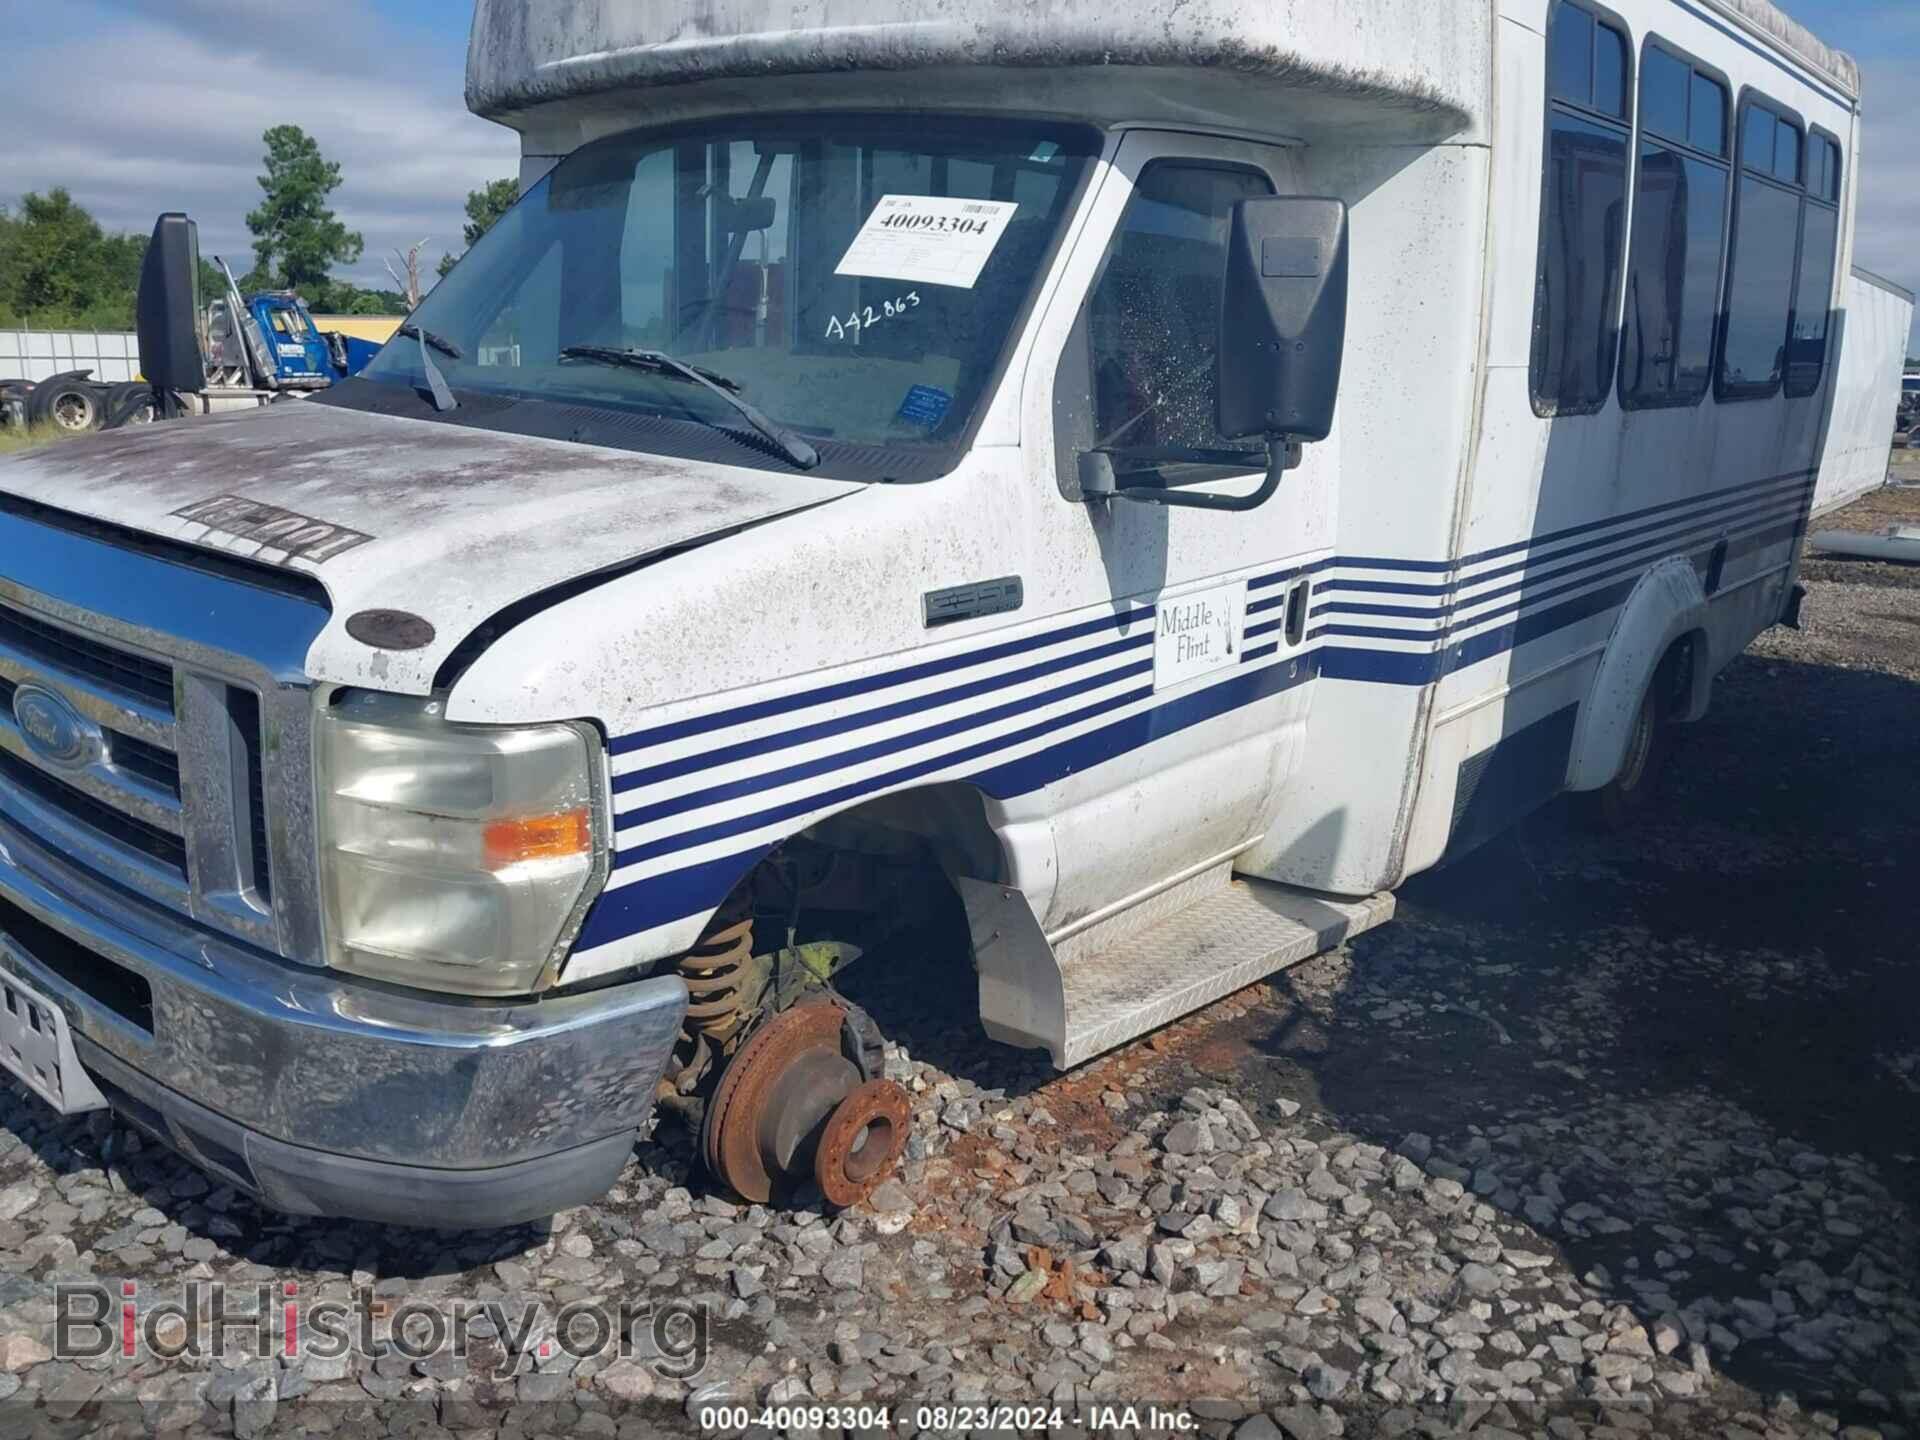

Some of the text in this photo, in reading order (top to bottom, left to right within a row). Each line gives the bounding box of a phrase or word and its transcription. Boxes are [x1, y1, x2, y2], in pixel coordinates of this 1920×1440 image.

[880, 212, 989, 236] 40093304
[1160, 601, 1213, 637] Middle
[1176, 630, 1210, 663] Flint
[24, 703, 58, 746] Ford
